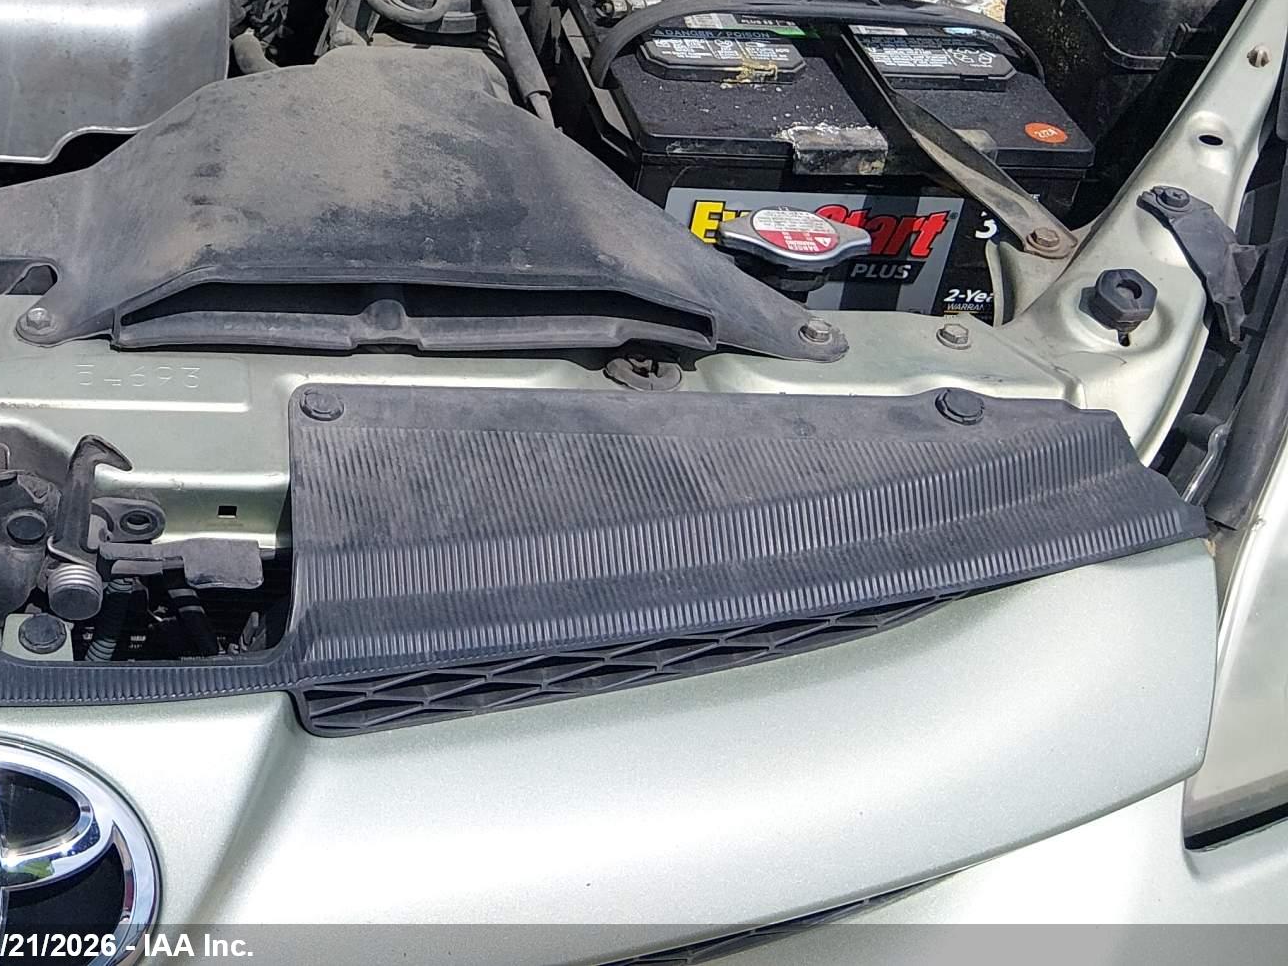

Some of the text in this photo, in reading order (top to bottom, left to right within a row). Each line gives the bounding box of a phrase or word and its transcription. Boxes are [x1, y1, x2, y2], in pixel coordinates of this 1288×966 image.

[665, 29, 714, 38] DANGER
[726, 31, 771, 39] POISON
[850, 263, 912, 280] PLUS
